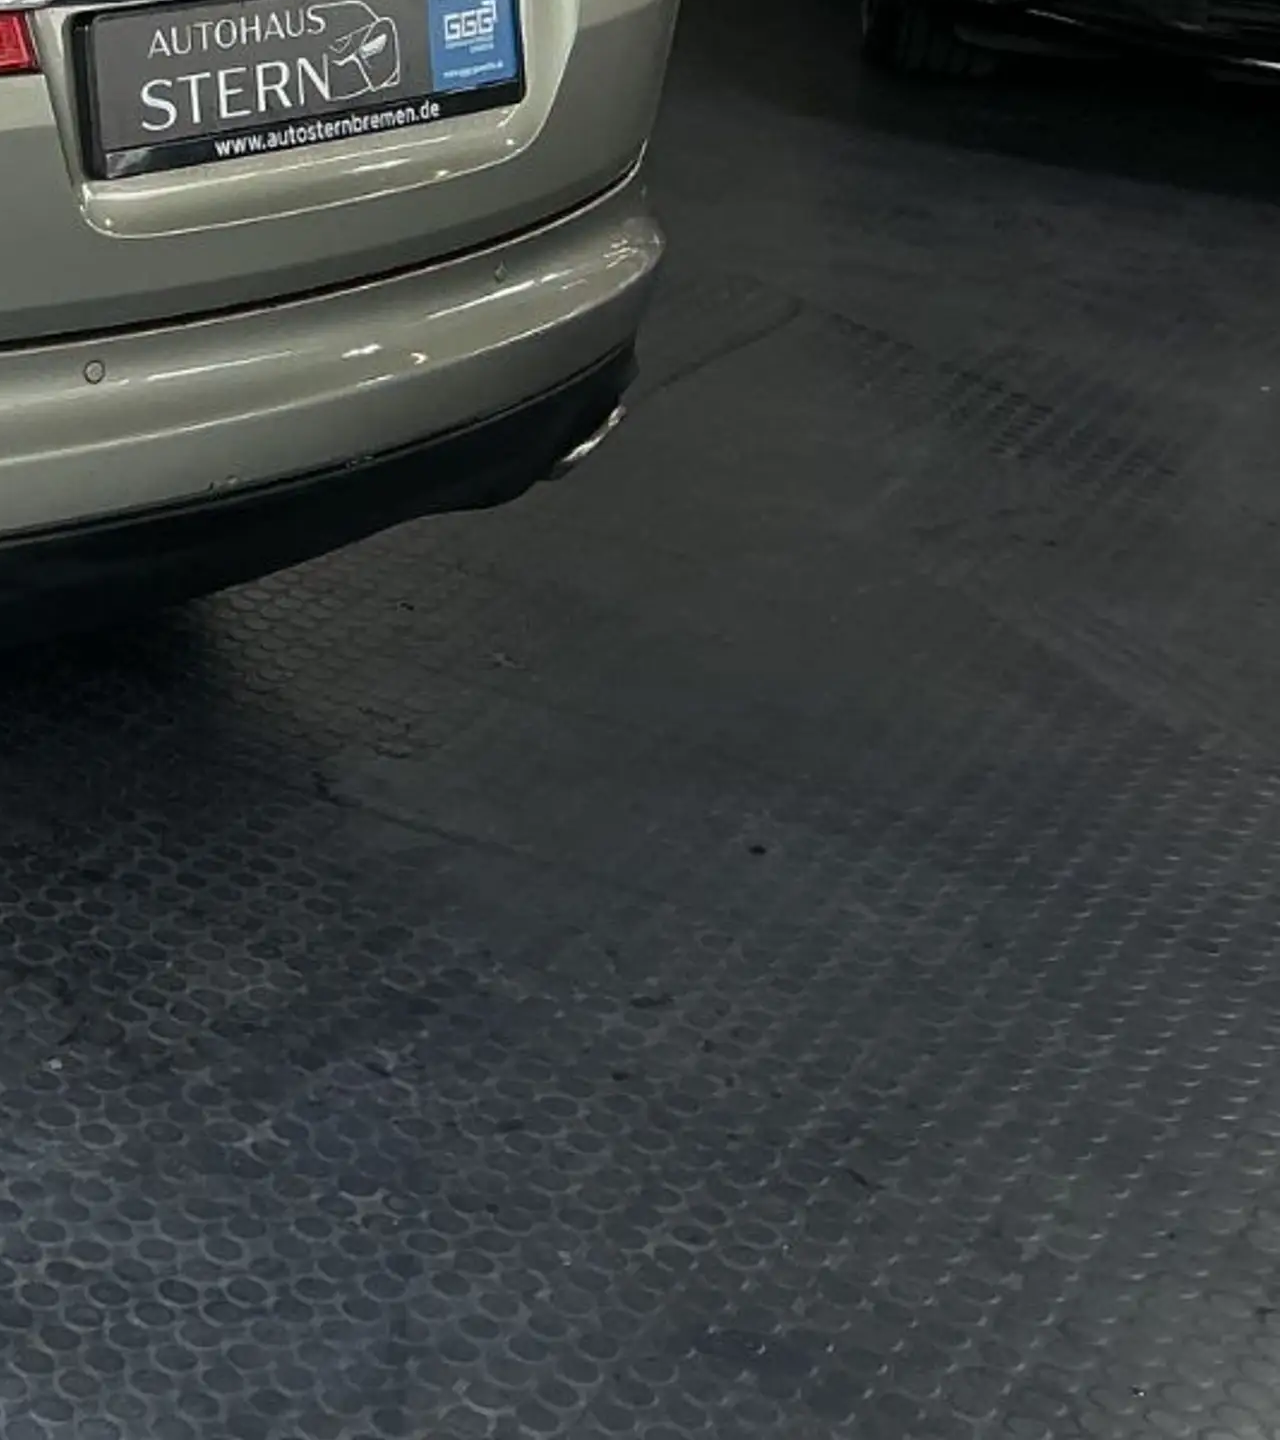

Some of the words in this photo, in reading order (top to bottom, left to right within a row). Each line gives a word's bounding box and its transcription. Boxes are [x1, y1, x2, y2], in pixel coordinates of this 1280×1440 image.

[147, 6, 327, 59] AUTOHAUS
[140, 53, 332, 132] STERN
[214, 100, 441, 157] www.autosternbremen.de
